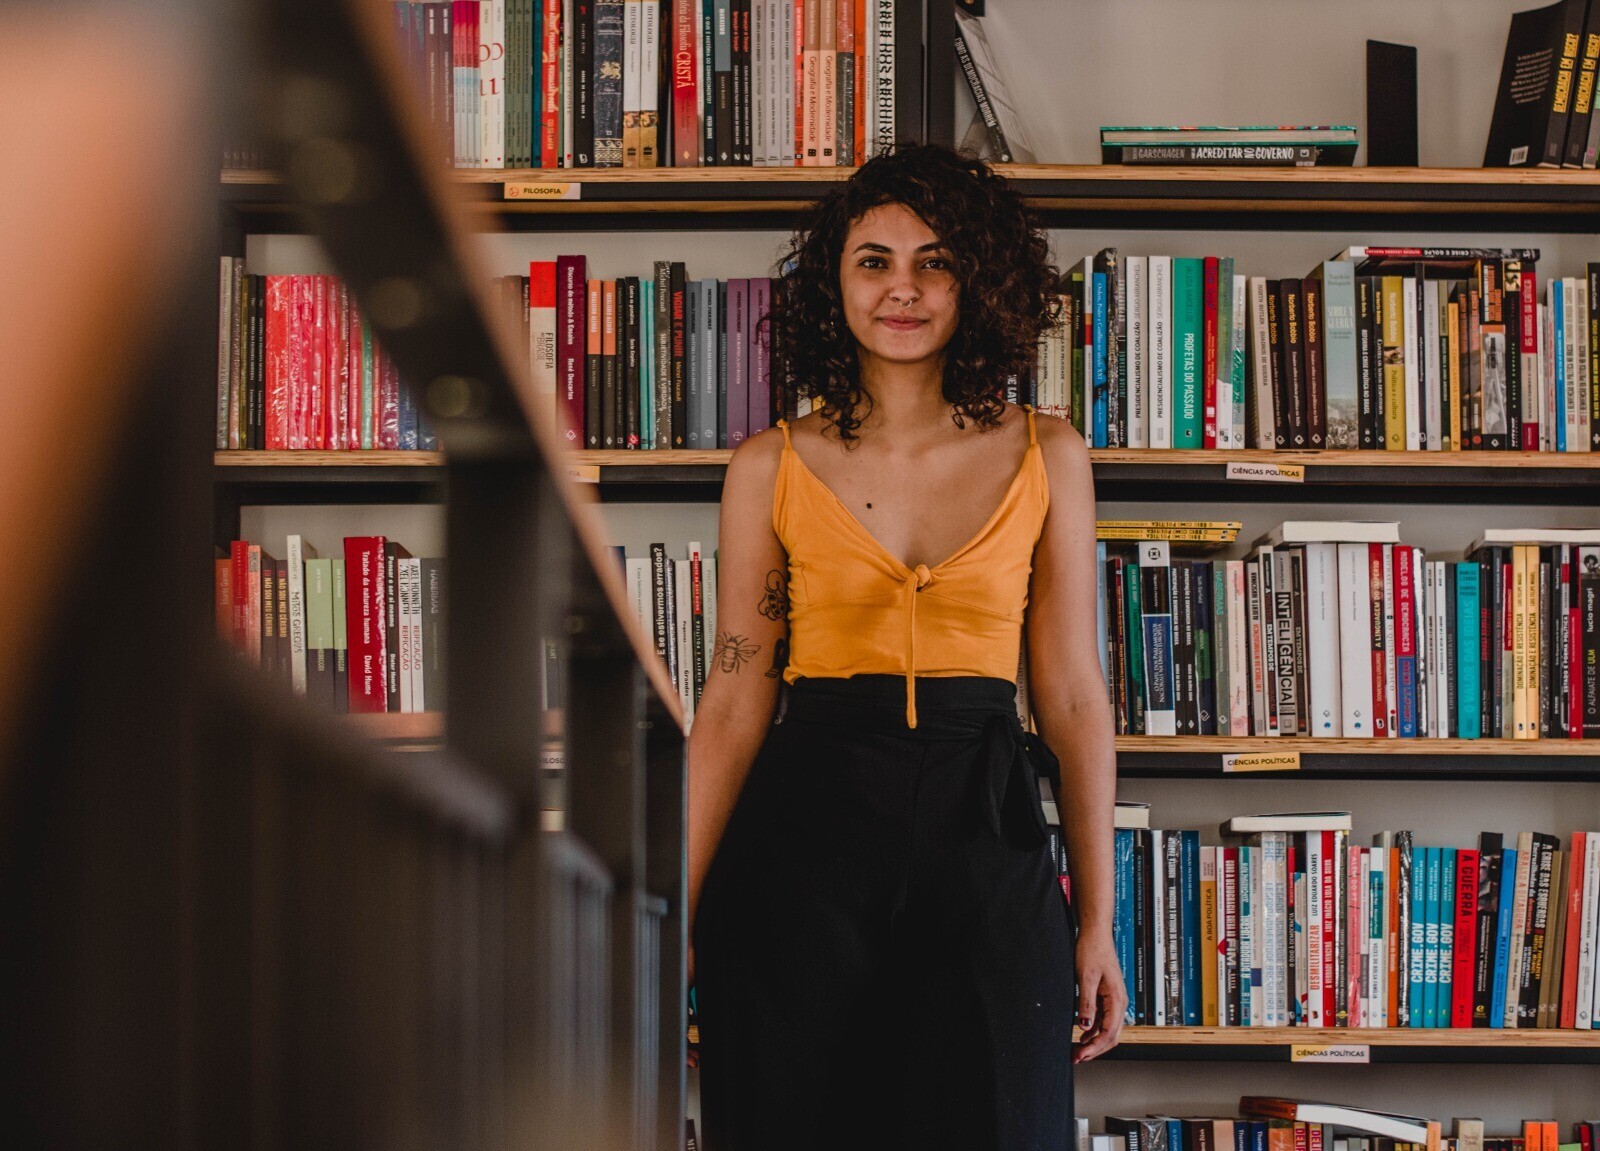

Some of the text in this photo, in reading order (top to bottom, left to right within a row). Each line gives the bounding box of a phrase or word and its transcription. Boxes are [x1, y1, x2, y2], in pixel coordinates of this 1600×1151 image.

[677, 52, 694, 88] CRISTÃ
[824, 56, 832, 89] Geografia
[955, 38, 996, 127] COMO AS DEMOCRACIAS MORREM
[1197, 148, 1242, 159] ACREDITAR
[1256, 148, 1294, 160] GOVERNO
[674, 291, 682, 319] VIGIAR
[1269, 295, 1277, 321] Norberto
[1307, 293, 1316, 342] Norberto Bobbio
[545, 333, 553, 369] FILOSOFIA
[674, 330, 682, 357] PUNIR
[1184, 333, 1194, 418] PROFETAS DO PASSADO
[362, 551, 370, 575] Tratado
[654, 548, 663, 585] errados?
[411, 565, 420, 614] AXEL HONNETH
[430, 569, 438, 614] HABERMAS
[1215, 571, 1223, 615] HABERMAS
[1374, 591, 1379, 600] DO
[1401, 589, 1408, 599] DE
[1401, 602, 1409, 652] DEMOCRACIA
[1463, 600, 1473, 637] IDEIAS
[1586, 588, 1594, 632] lucio magri
[413, 625, 421, 670] REIFICAÇÃO
[658, 637, 665, 647] se
[1278, 594, 1293, 702] INTELIGÊNCIA
[1464, 641, 1473, 662] DAS
[1587, 649, 1595, 664] ULM
[364, 655, 372, 673] David
[1516, 655, 1524, 689] DOMINAÇÃO
[1588, 666, 1596, 674] DE
[1465, 665, 1474, 702] VALOR
[1588, 676, 1596, 706] ALFAIATE
[1518, 851, 1530, 880] ABAIXO
[1539, 873, 1550, 887] DAS
[1541, 852, 1551, 871] CRISE
[1460, 867, 1473, 916] GUERRA
[1526, 842, 1540, 934] Encruzilhadas da democracia
[1515, 890, 1526, 929] DITADURA
[1535, 889, 1549, 928] ESQUERDAS
[1309, 925, 1319, 990] DESMILITARIZAR
[1411, 923, 1424, 982] CRIME.GOV
[1426, 923, 1438, 983] CRIME.GOV
[1440, 923, 1452, 983] CRIME.GOV
